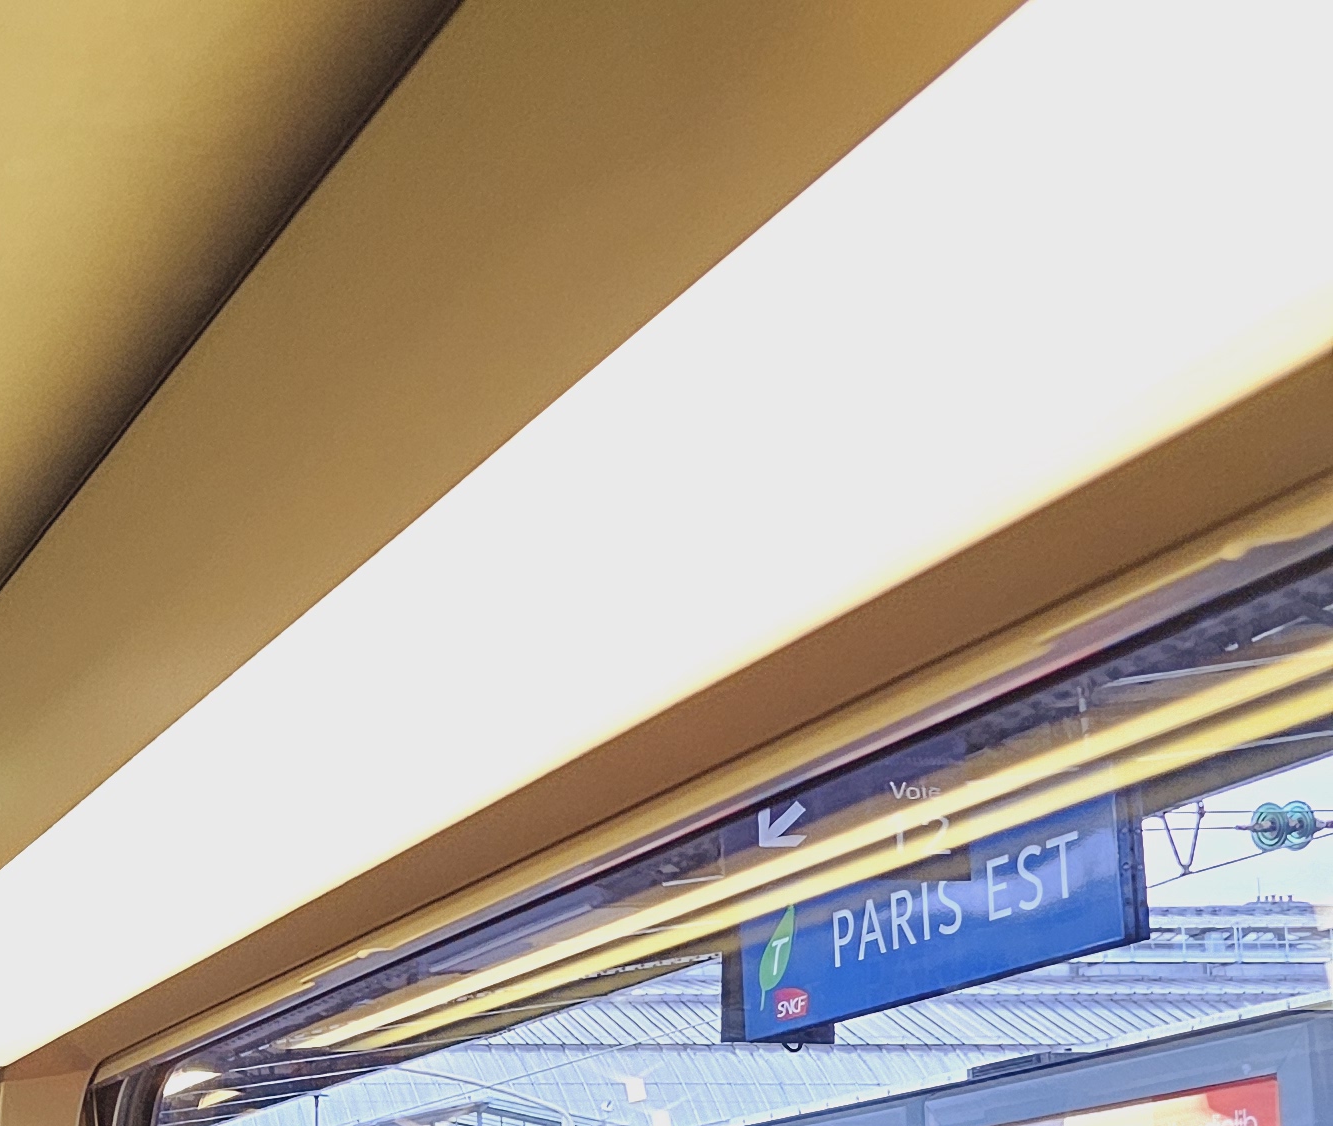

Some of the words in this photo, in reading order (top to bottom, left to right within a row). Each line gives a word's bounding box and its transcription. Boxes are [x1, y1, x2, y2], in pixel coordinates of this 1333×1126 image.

[889, 781, 941, 800] Voie
[833, 881, 962, 967] PARIS
[986, 831, 1079, 921] EST
[777, 995, 808, 1018] SNCF
